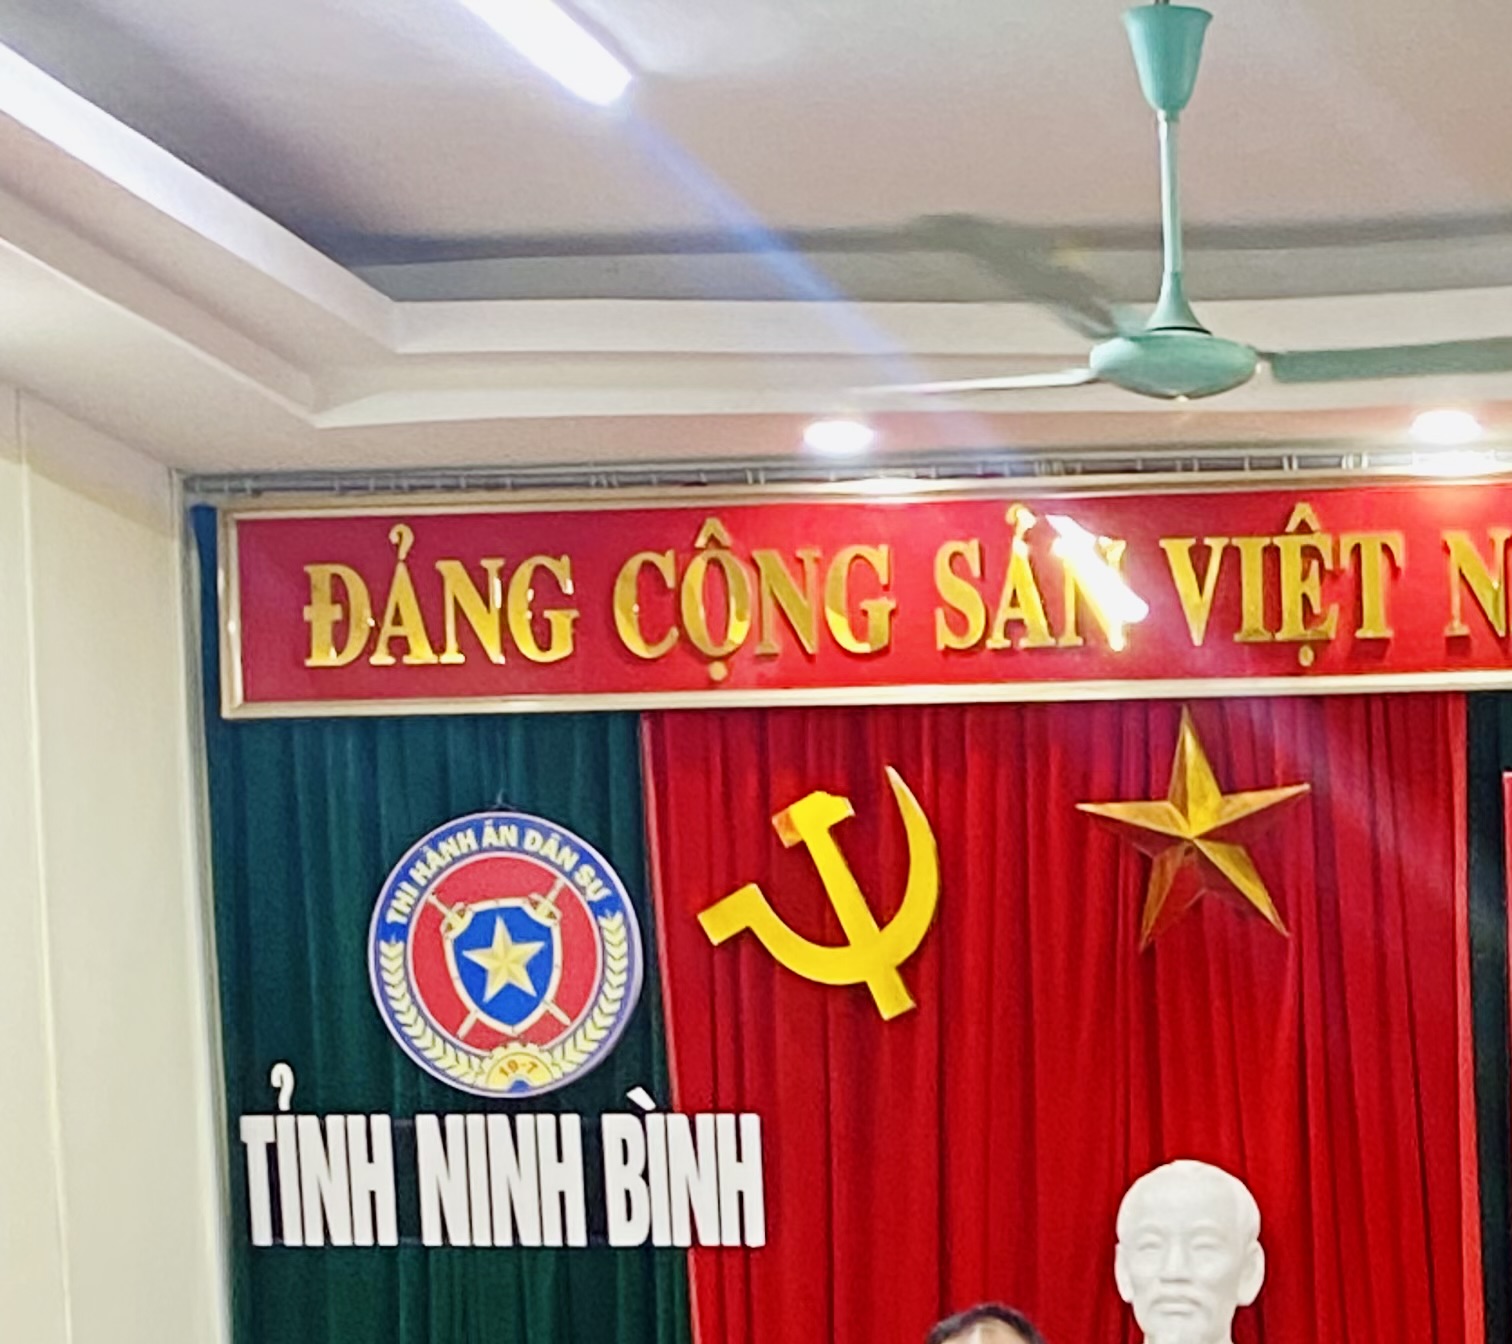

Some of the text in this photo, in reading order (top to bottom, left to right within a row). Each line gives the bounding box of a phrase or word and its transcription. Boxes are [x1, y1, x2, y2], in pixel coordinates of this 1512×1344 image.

[304, 524, 578, 667] ĐẢNG
[611, 518, 896, 683] CỘNG
[1160, 502, 1404, 667] VIỆT
[386, 881, 419, 924] THI
[240, 1062, 766, 1248] TỈNH NINH BÌNH
